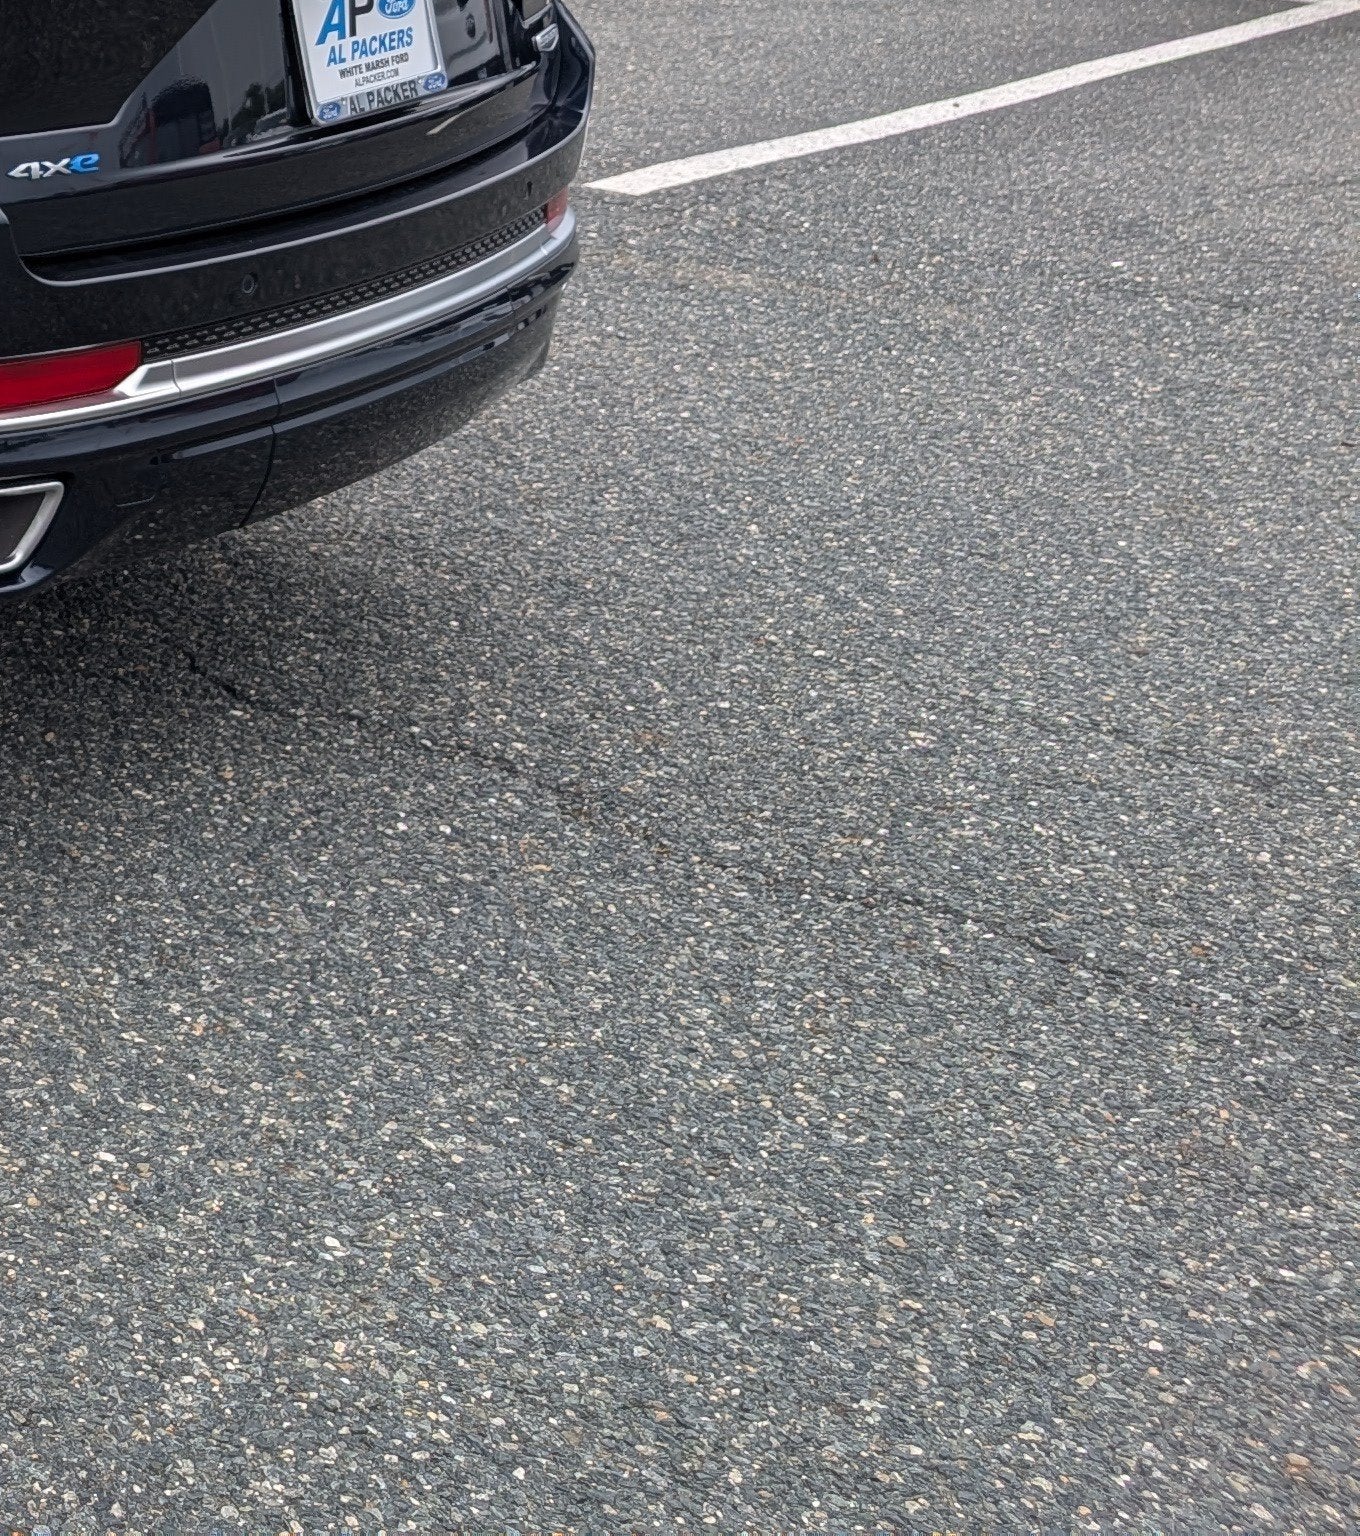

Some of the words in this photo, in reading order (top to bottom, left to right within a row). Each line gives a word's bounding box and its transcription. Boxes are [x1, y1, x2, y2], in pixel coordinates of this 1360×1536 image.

[326, 44, 347, 67] AL
[351, 27, 414, 61] PACKERS
[338, 63, 364, 80] WHITE
[365, 56, 391, 73] MARSH
[391, 52, 410, 65] FORD
[349, 97, 366, 115] AL
[367, 79, 420, 112] PACKER
